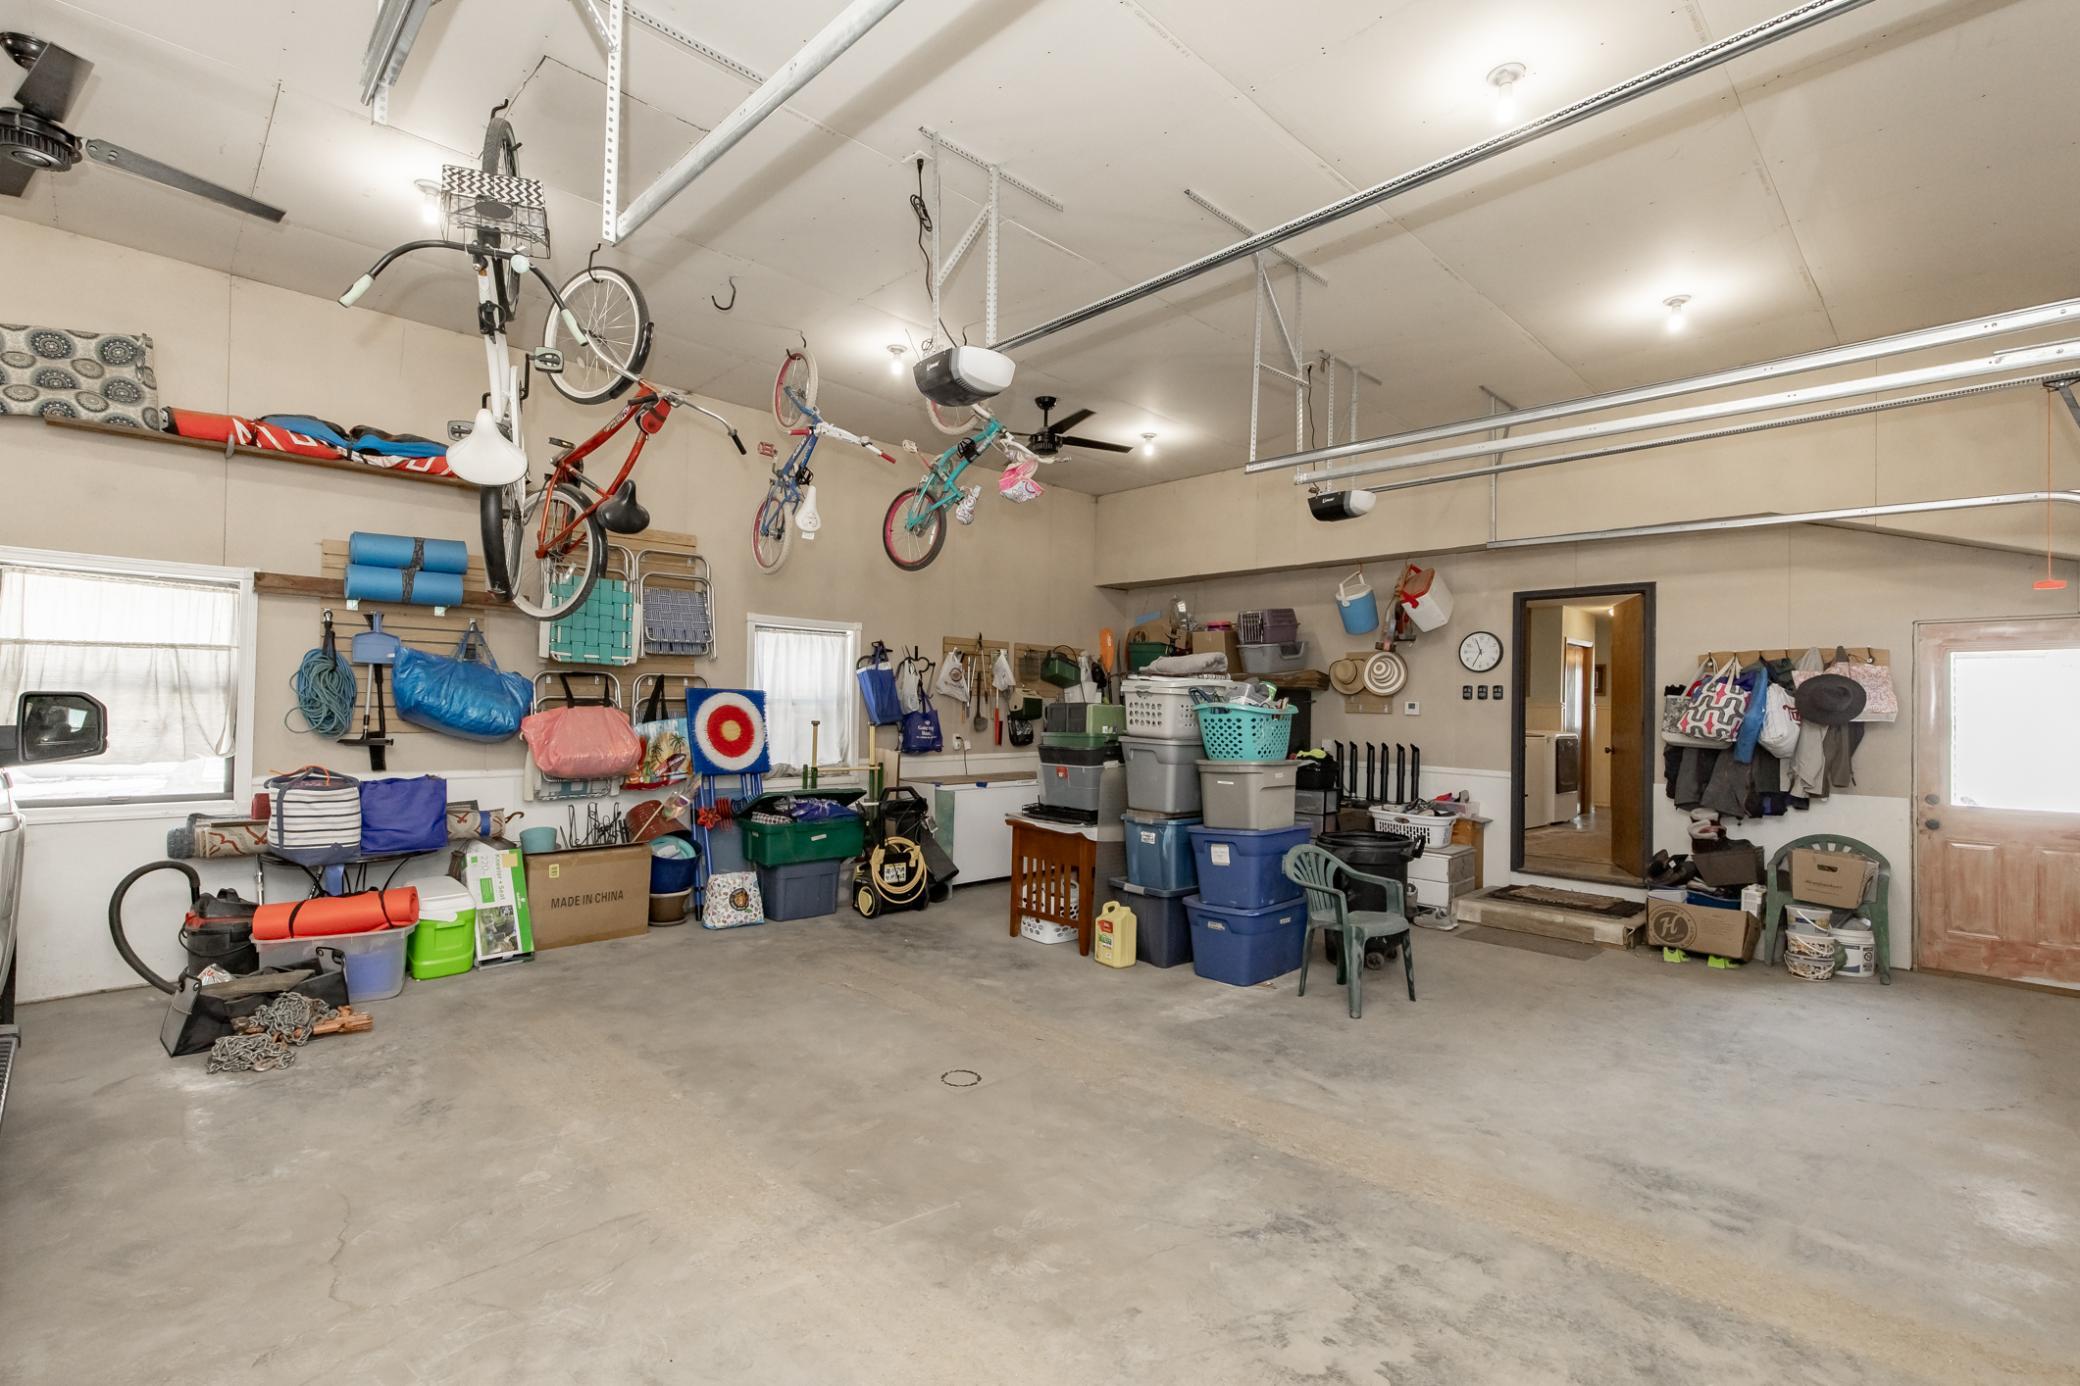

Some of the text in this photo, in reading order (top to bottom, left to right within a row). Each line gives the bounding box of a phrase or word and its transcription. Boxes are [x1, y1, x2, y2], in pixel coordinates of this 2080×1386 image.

[551, 889, 624, 909] MADE IN CHINA
